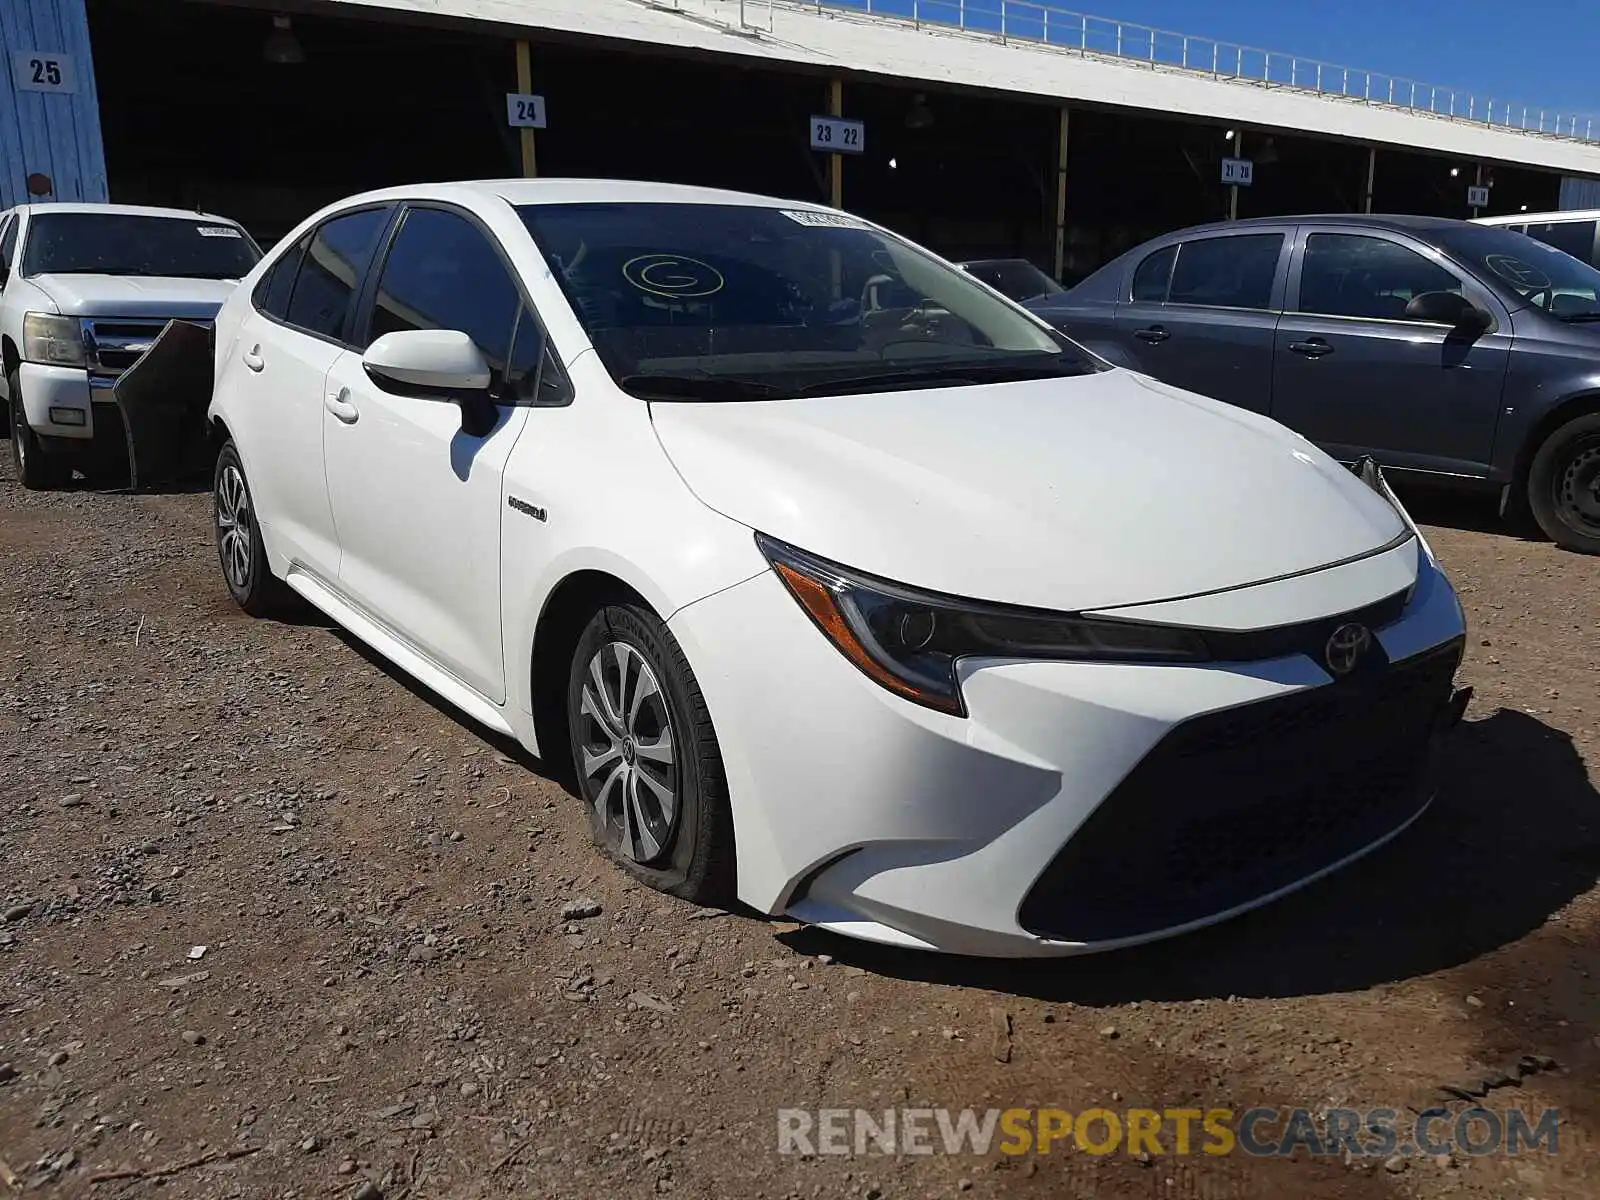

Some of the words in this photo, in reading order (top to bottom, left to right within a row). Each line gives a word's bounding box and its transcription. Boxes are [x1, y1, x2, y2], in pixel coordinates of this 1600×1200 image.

[30, 59, 61, 85] 25
[517, 101, 536, 121] 24
[817, 124, 832, 142] 23
[843, 128, 858, 145] 22
